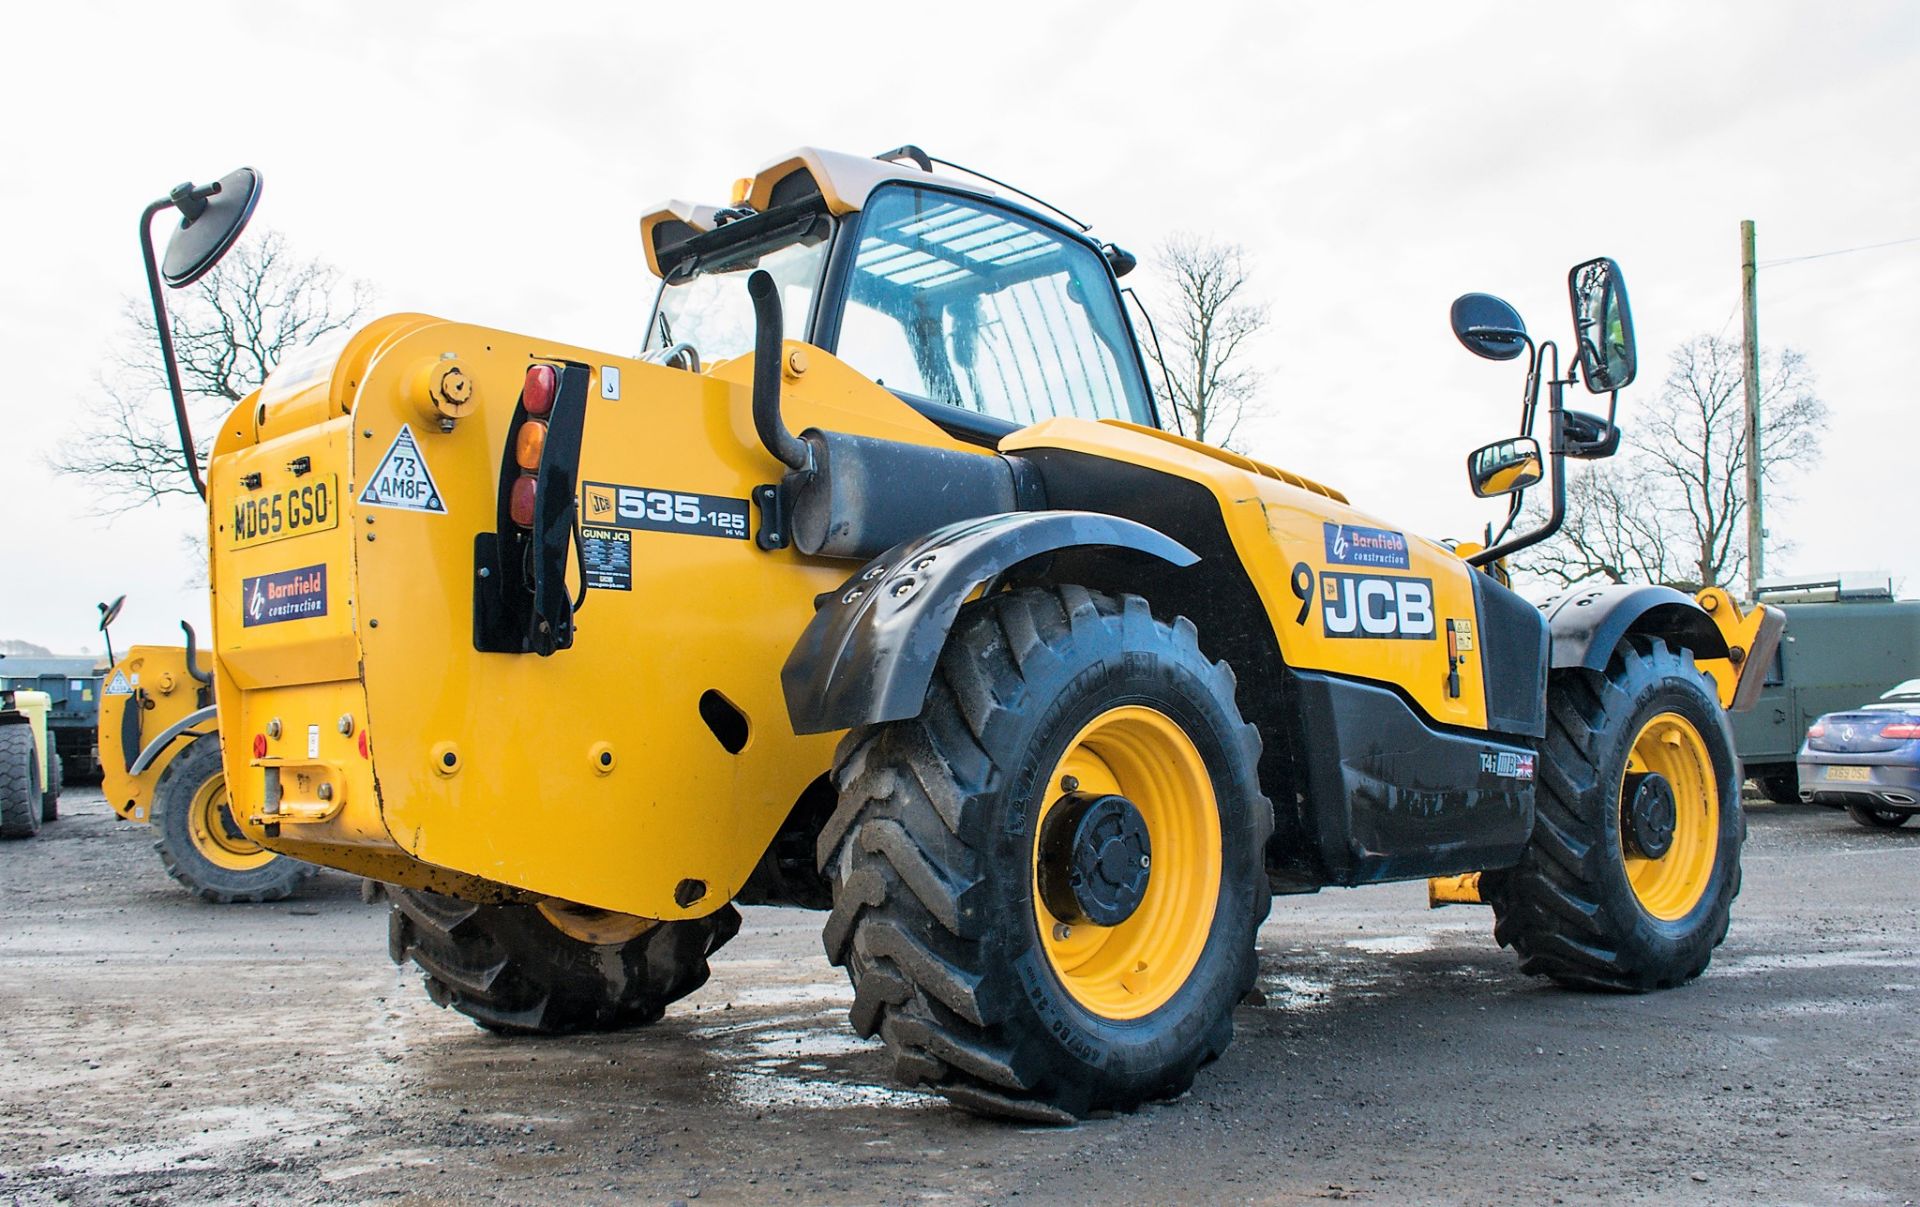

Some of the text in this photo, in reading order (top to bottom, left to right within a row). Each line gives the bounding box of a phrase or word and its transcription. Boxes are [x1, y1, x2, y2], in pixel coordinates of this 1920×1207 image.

[394, 456, 415, 477] 73
[381, 477, 427, 499] AM8F
[235, 483, 327, 541] MD65 GSO
[583, 530, 630, 542] GUNN JCB
[1352, 532, 1403, 551] Barnfield
[1354, 552, 1404, 564] construction
[268, 572, 321, 599] Barnfield
[1291, 562, 1315, 626] 9
[269, 598, 321, 617] construction
[1325, 578, 1433, 633] JCB
[1480, 753, 1497, 773] T4i
